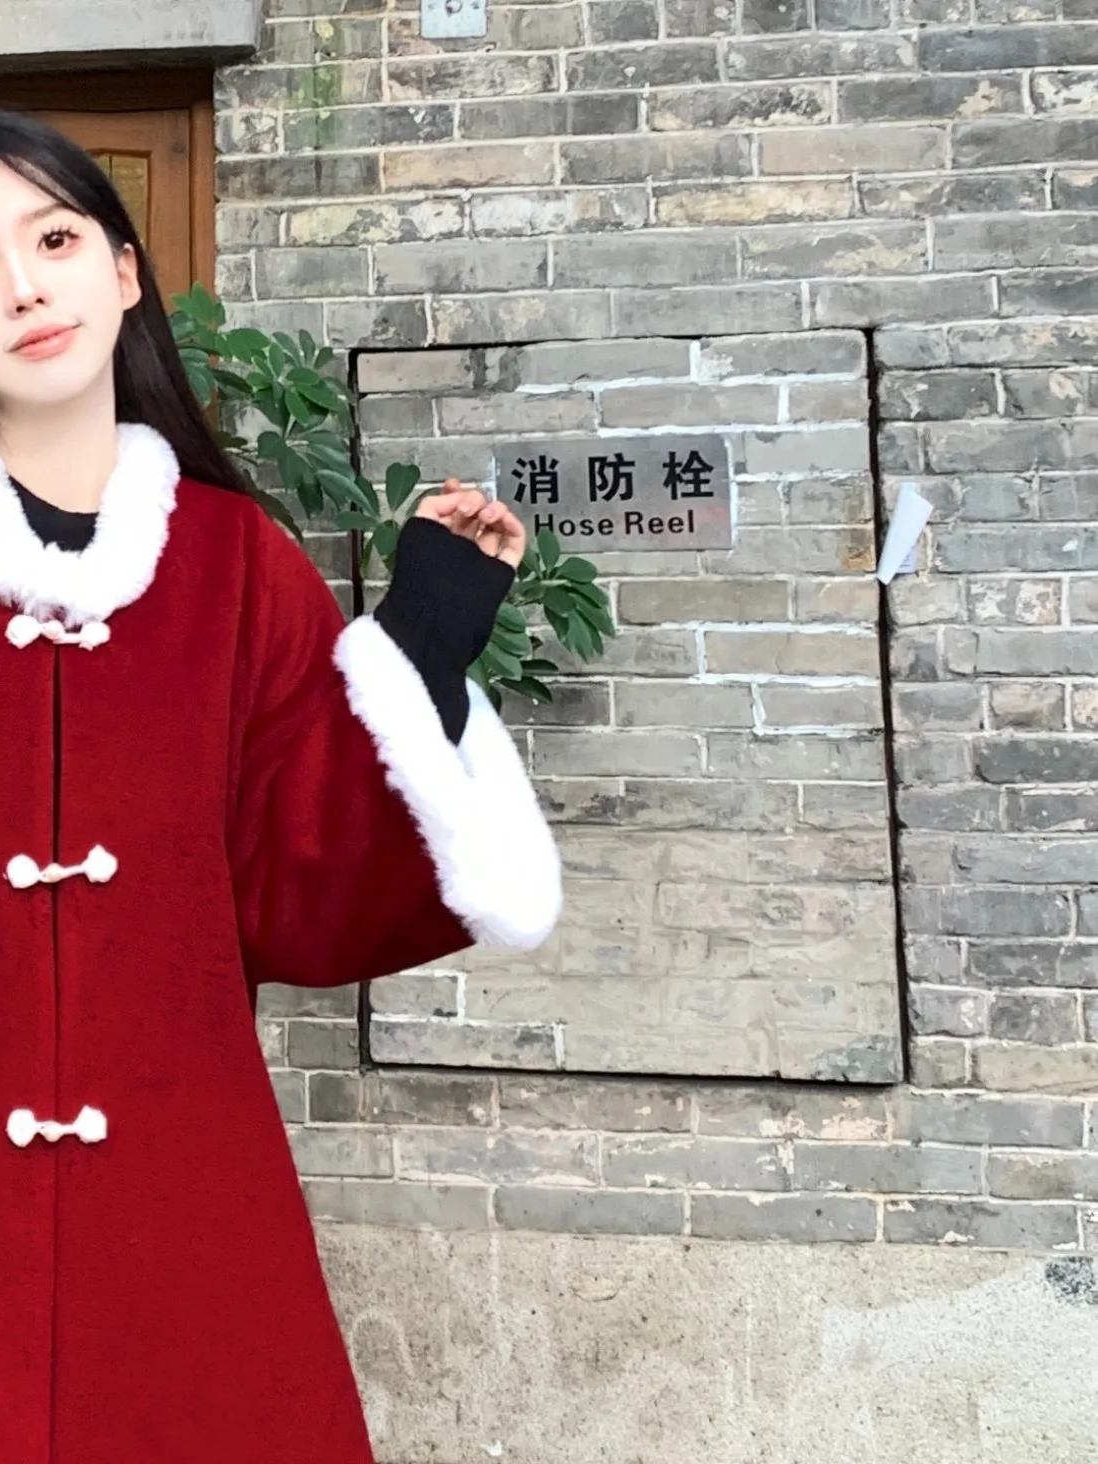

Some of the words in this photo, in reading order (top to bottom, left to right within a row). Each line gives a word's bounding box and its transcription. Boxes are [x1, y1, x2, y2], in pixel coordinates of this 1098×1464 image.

[510, 450, 714, 504] 消防栓
[534, 513, 614, 537] Hose
[624, 509, 695, 535] Reel
